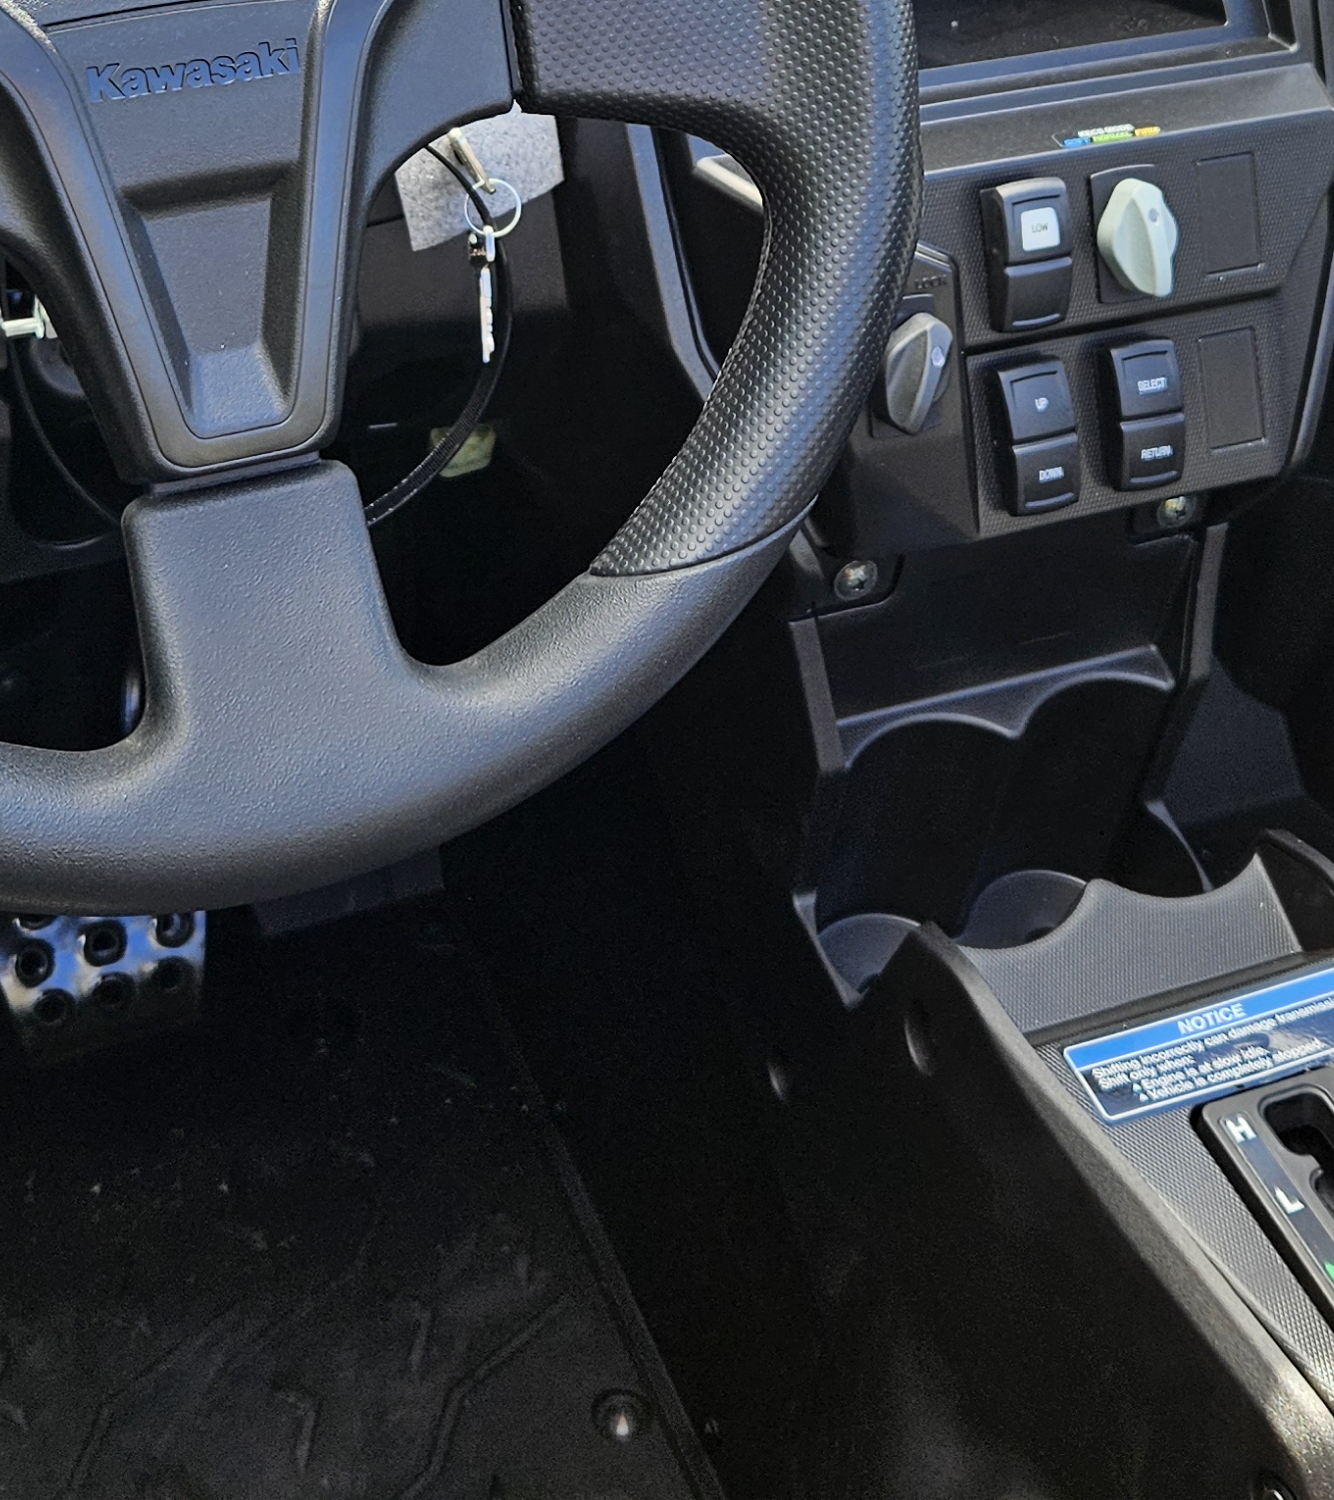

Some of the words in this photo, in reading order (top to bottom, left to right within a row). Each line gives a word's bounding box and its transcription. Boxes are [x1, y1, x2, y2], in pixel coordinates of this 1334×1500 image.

[86, 37, 300, 104] Kawasaki
[1031, 223, 1049, 233] LOW
[914, 274, 948, 290] LOCK
[1137, 376, 1168, 395] SELECT
[1035, 397, 1049, 412] UP
[1141, 444, 1174, 462] RETURN
[1039, 466, 1065, 483] DOWN
[1177, 1002, 1247, 1035] NOTICE
[1092, 1059, 1142, 1080] Shifting
[1139, 1039, 1206, 1064] incorrectly
[1204, 1033, 1228, 1047] can
[1227, 1017, 1277, 1039] damage
[1098, 1072, 1131, 1092] Shift
[1129, 1065, 1158, 1080] only
[1156, 1055, 1196, 1073] when:
[1141, 1071, 1187, 1090] Engine
[1184, 1066, 1199, 1078] is
[1198, 1061, 1215, 1075] at
[1212, 1053, 1242, 1070] slow
[1147, 1080, 1194, 1101] Vehicle
[1193, 1076, 1208, 1088] is
[1207, 1056, 1273, 1083] completely
[1223, 1115, 1258, 1144] H
[1274, 1186, 1307, 1215] L
